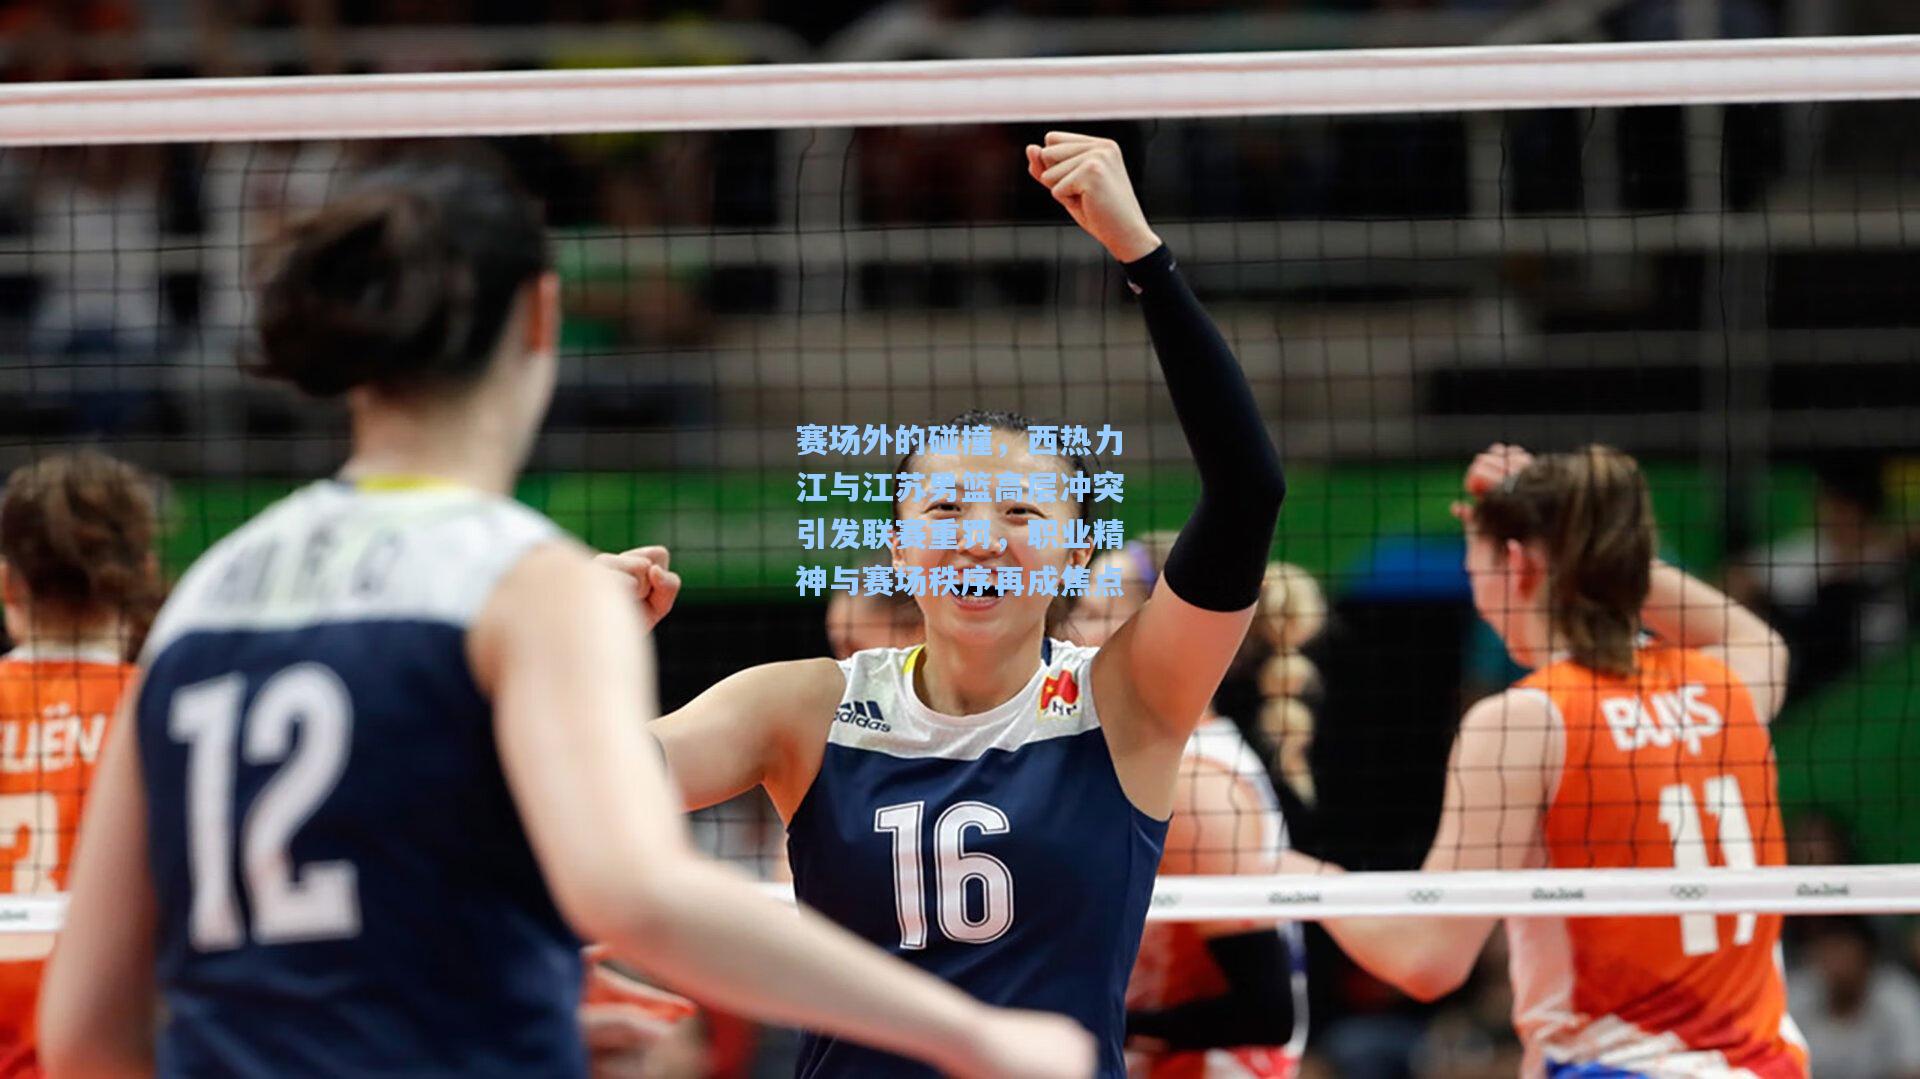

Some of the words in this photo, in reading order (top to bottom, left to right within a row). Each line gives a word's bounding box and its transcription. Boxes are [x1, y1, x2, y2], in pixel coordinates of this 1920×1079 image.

[168, 662, 362, 952] 12
[874, 800, 1014, 949] 16
[1658, 774, 1757, 956] 11
